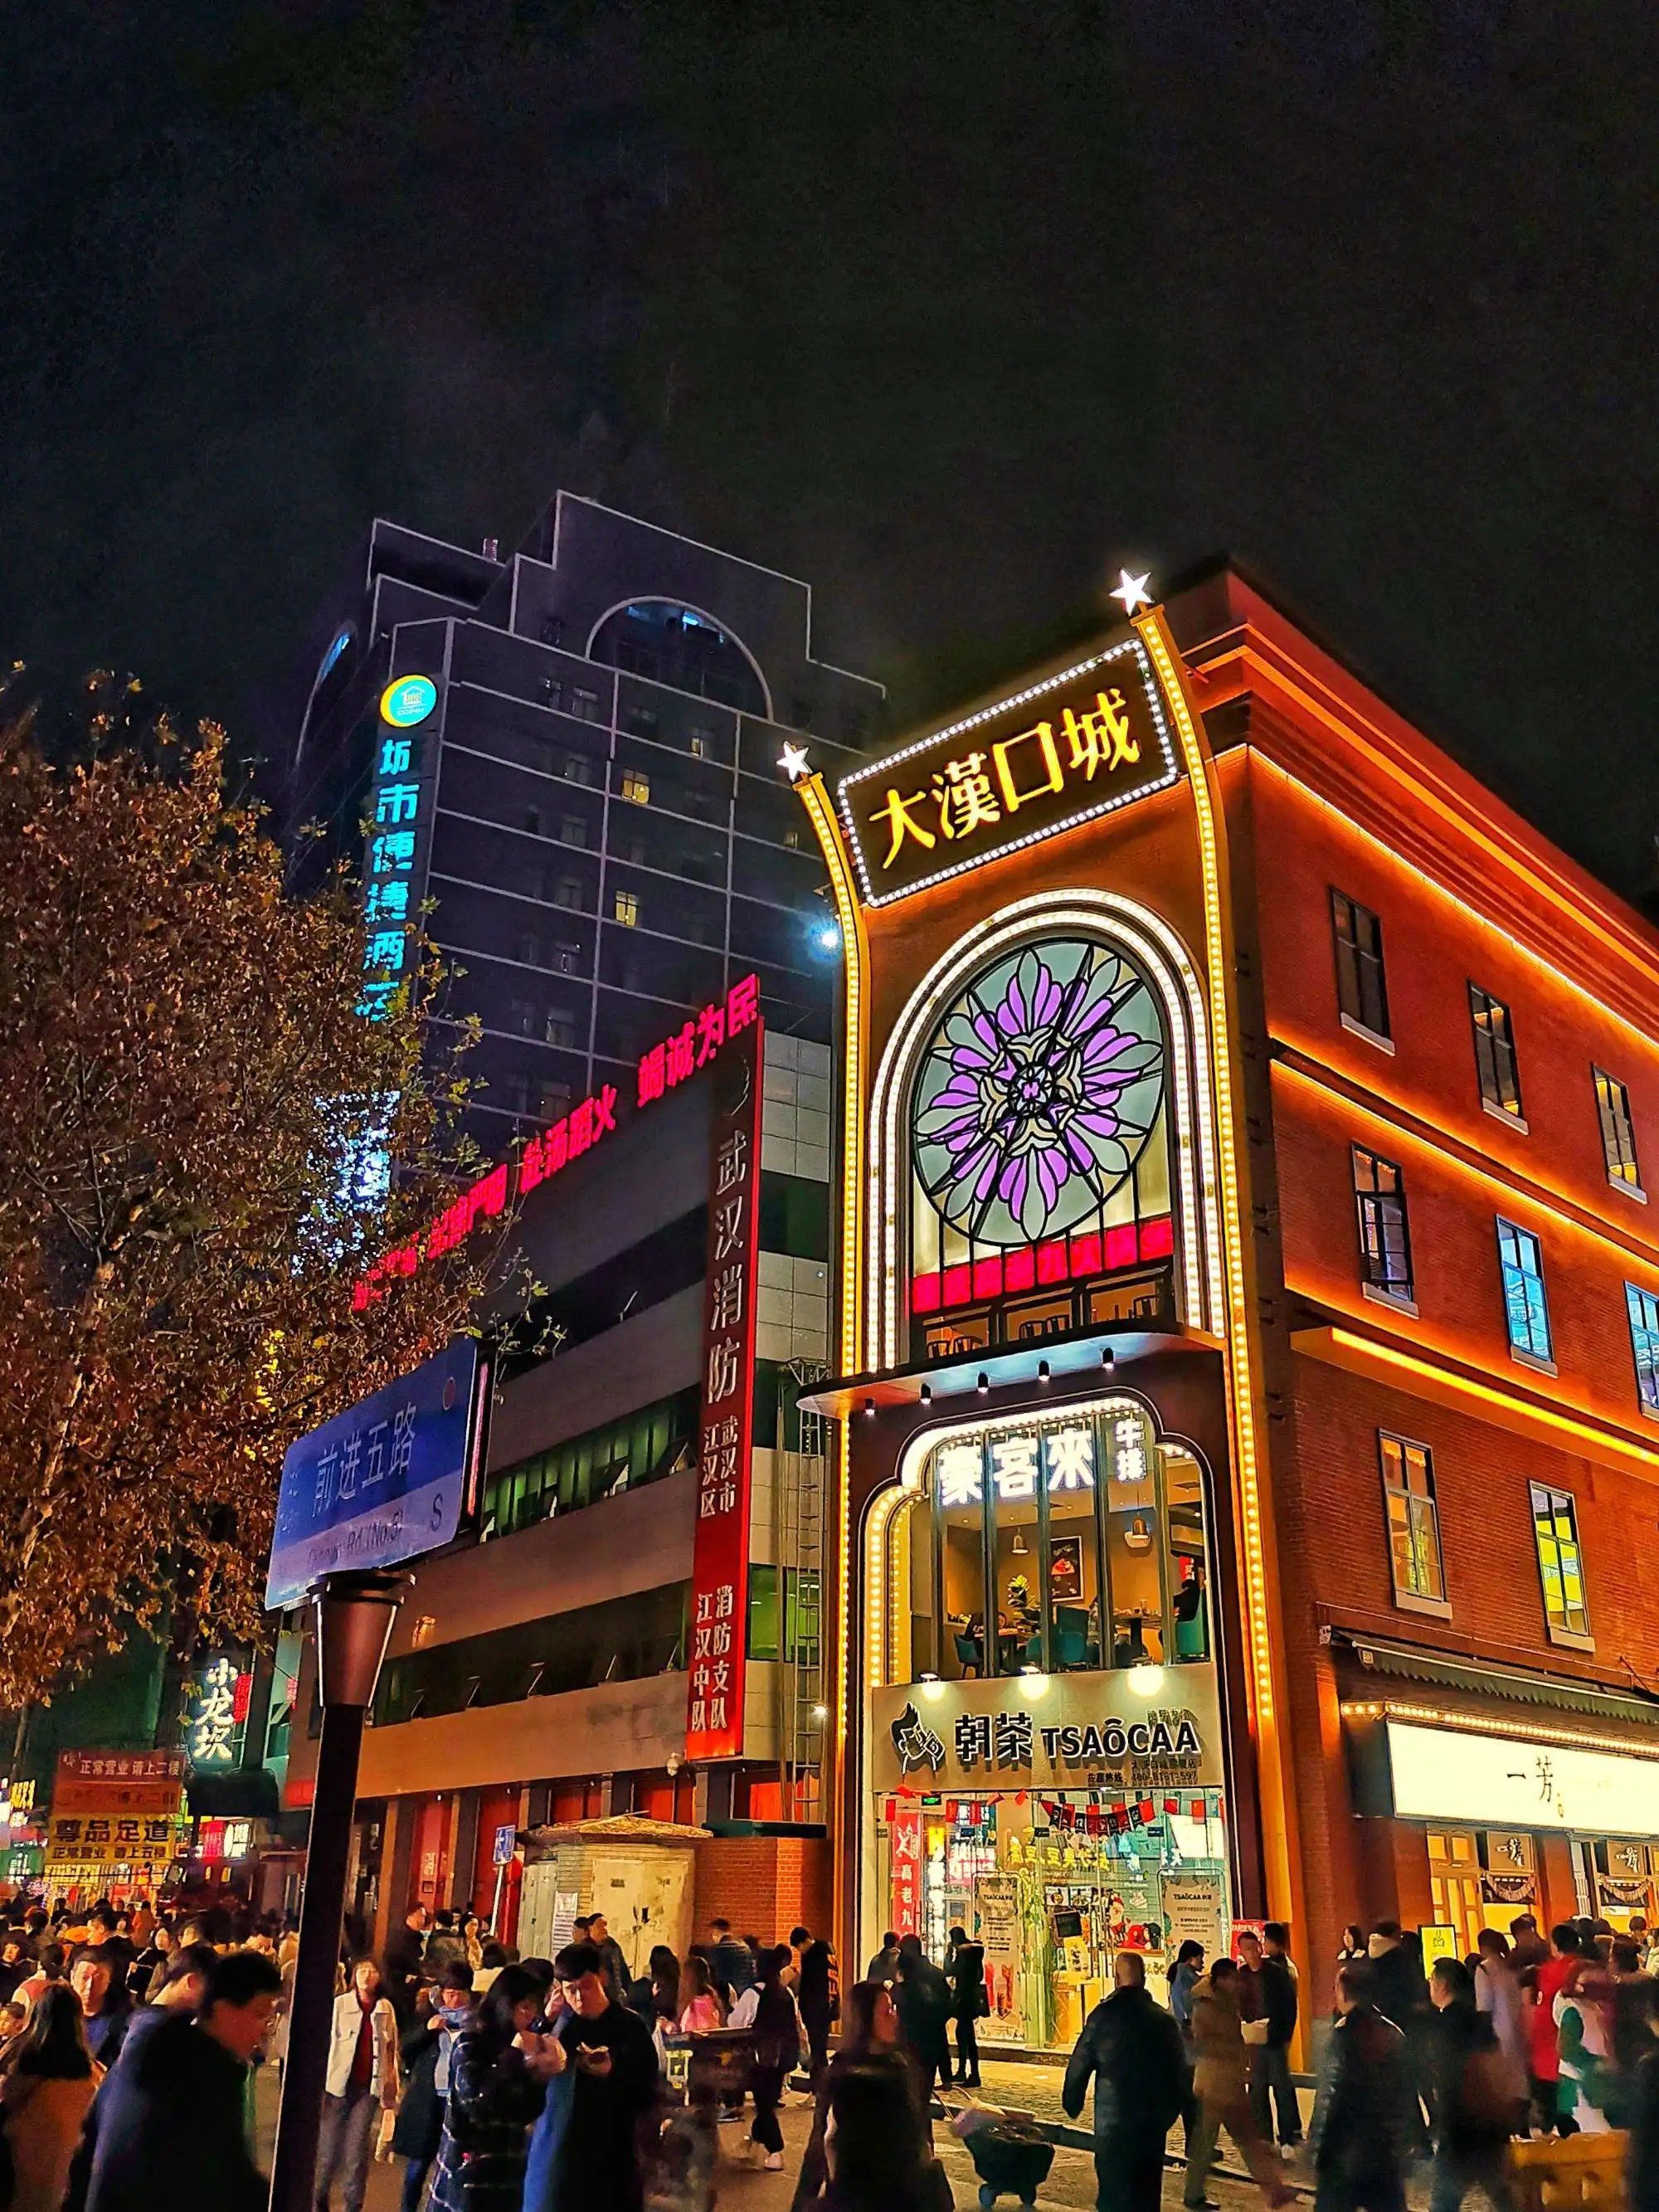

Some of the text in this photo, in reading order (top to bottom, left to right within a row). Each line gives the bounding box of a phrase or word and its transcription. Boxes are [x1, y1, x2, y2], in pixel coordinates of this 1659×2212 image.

[868, 688, 1141, 870] 大漢口城
[708, 1129, 747, 1404] 武汉消防
[312, 1402, 417, 1518] 前进五路
[701, 1424, 719, 1518] 江汉区
[719, 1415, 738, 1513] 武汉市
[431, 1493, 443, 1532] S
[692, 1593, 713, 1732] 江汉中队
[709, 1585, 732, 1730] 消防支队
[193, 1658, 238, 1760] 小龙坎
[955, 1712, 1034, 1762] 朝茶
[1506, 1756, 1554, 1803] 一芳
[56, 1819, 169, 1842] 尊品足道
[901, 1864, 912, 1936] 高老九
